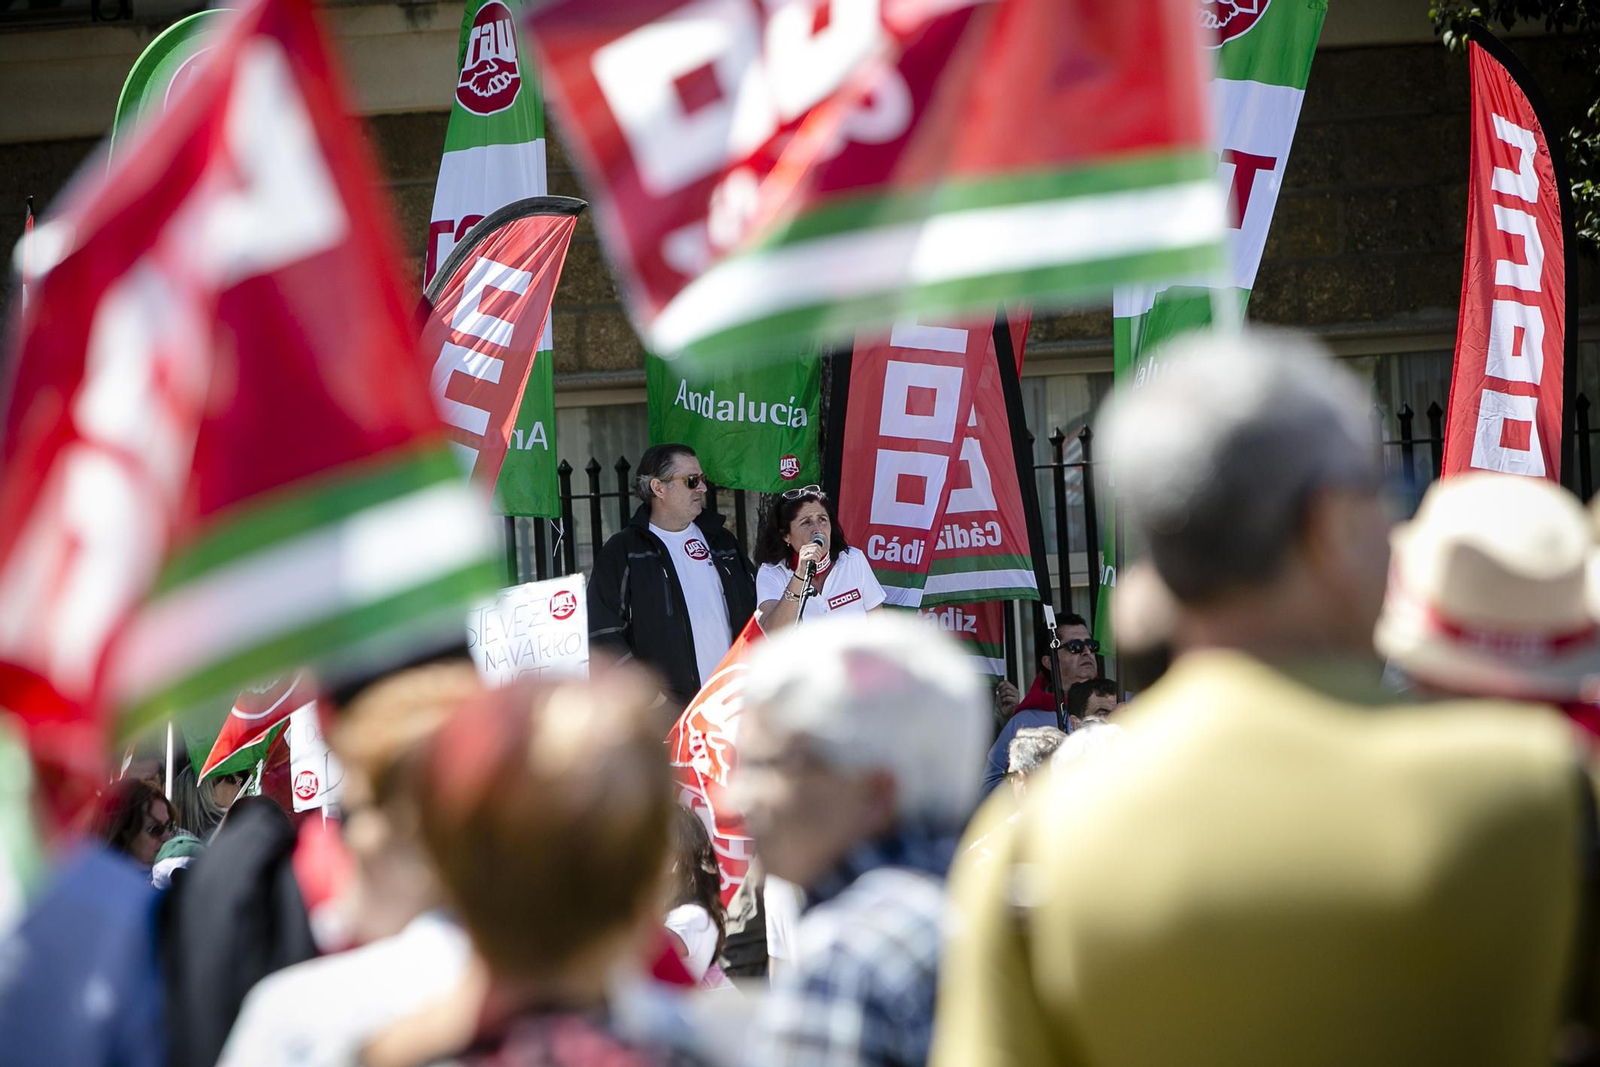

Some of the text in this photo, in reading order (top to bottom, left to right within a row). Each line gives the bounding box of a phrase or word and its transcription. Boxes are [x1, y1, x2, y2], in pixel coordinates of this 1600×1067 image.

[674, 378, 808, 429] Andalucía
[916, 606, 978, 634] ádiz
[484, 632, 582, 672] NAVARRO
